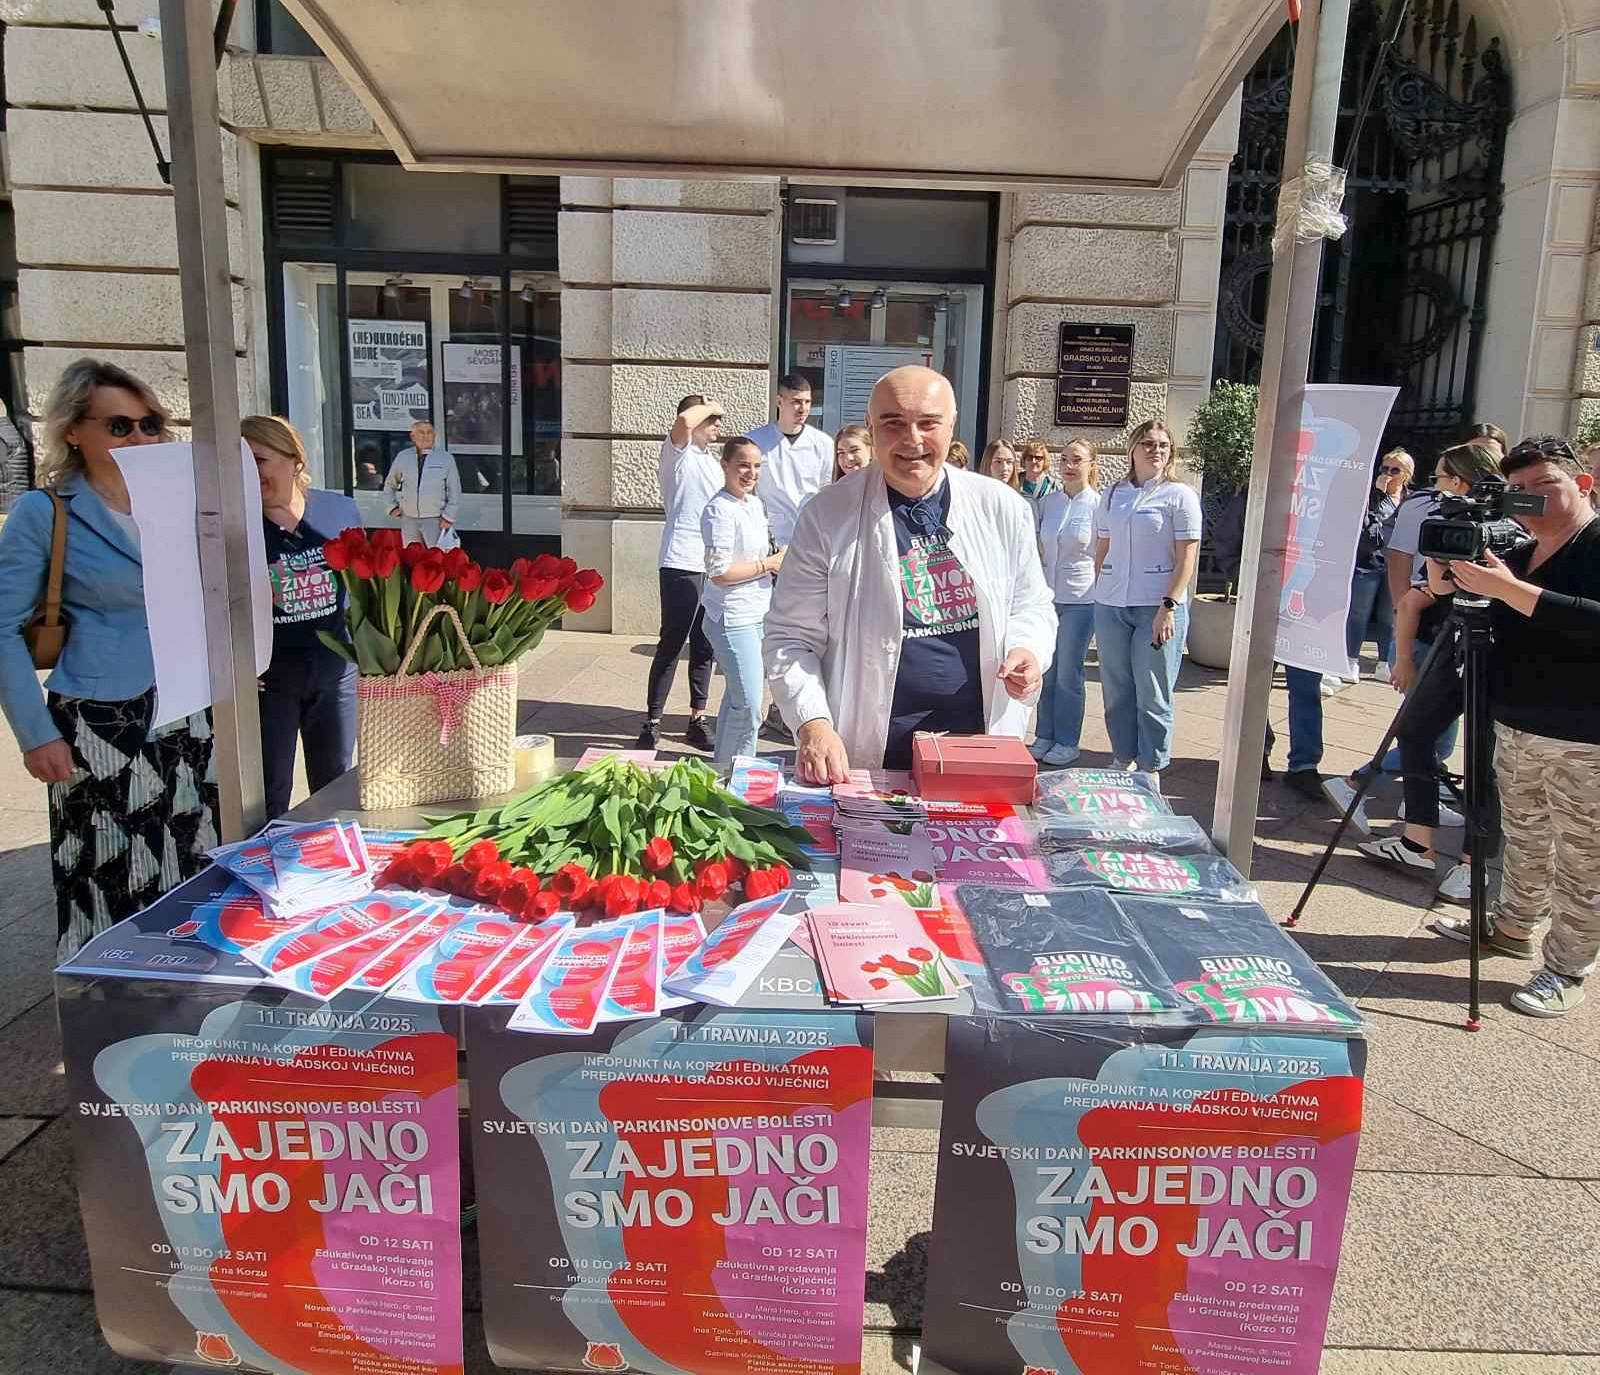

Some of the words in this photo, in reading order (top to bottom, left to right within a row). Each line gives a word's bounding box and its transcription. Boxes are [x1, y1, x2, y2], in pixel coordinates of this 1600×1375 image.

[352, 346, 379, 360] MORE
[473, 348, 501, 357] MOST
[1063, 354, 1100, 362] GRADSKO
[1102, 354, 1129, 363] VIJEĆE
[382, 391, 427, 407] (UN)TAMED
[1060, 404, 1125, 414] GRADONAČELNIK
[281, 569, 333, 592] ŽIVOT
[282, 588, 311, 601] NIJE
[284, 601, 311, 614] ČAK
[313, 598, 327, 608] NI
[329, 594, 337, 604] S
[273, 605, 337, 624] ARKINSONOM
[1034, 953, 1129, 971] BUDIMO
[1200, 956, 1294, 977] BUDIMO
[1041, 963, 1134, 980] #ZAJEDNO
[1212, 970, 1303, 987] #ZAJEDNO
[759, 977, 812, 993] KBC
[257, 1010, 281, 1024] 11.
[285, 1011, 366, 1030] TRAVNJA
[369, 1016, 417, 1032] 2025.
[670, 1026, 695, 1040] 11.
[701, 1027, 782, 1044] TRAVNJA
[786, 1031, 833, 1046] 2025.
[173, 1038, 249, 1051] INFOPUNKT
[252, 1042, 271, 1053] NA
[273, 1043, 318, 1056] KORZU
[330, 1047, 415, 1062] EDUKATIVNA
[171, 1051, 261, 1066] PREDAVANJA
[263, 1056, 272, 1066] U
[276, 1058, 349, 1071] GRADSKOJ
[351, 1060, 415, 1076] VIJEĆNICI
[583, 1056, 659, 1069] INFOPUNKT
[663, 1060, 682, 1070] NA
[686, 1061, 732, 1072] KORZU
[743, 1063, 829, 1076] EDUKATIVNA
[1159, 1053, 1184, 1067] 11.
[1190, 1054, 1273, 1073] TRAVNJA
[1277, 1059, 1325, 1076] 2025.
[581, 1070, 671, 1084] PREDAVANJA
[674, 1074, 683, 1084] U
[687, 1075, 761, 1087] GRADSKOJ
[765, 1075, 829, 1089] VIJEĆNICI
[1068, 1082, 1146, 1097] INFOPUNKT
[1150, 1087, 1168, 1098] NA
[1173, 1088, 1220, 1101] KORZU
[1231, 1092, 1320, 1106] EDUKATIVNA
[79, 1101, 161, 1117] SVJETSKI
[165, 1102, 201, 1116] DAN
[208, 1101, 344, 1114] PARKINSONOVE
[348, 1101, 422, 1115] BOLESTI
[1063, 1096, 1157, 1112] PREDAVANJA
[1159, 1103, 1168, 1112] U
[1172, 1103, 1248, 1117] GRADSKOJ
[1251, 1106, 1318, 1121] VIJEĆNICI
[482, 1120, 566, 1135] SVJETSKI
[571, 1121, 608, 1134] DAN
[613, 1116, 753, 1133] PARKINSONOVE
[757, 1114, 832, 1129] BOLESTI
[160, 1120, 430, 1164] ZAJEDNO
[951, 1142, 1040, 1160] SVJETSKI
[1045, 1147, 1083, 1160] DAN
[1088, 1146, 1232, 1160] PARKINSONOVE
[1237, 1146, 1317, 1160] BOLESTI
[565, 1134, 839, 1180] ZAJEDNO
[159, 1172, 291, 1216] SMO
[308, 1163, 434, 1216] JAČI
[1034, 1165, 1318, 1208] ZAJEDNO
[564, 1188, 694, 1228] SMO
[711, 1176, 840, 1227] JAČI
[359, 1235, 380, 1247] OD
[384, 1237, 399, 1248] 12
[402, 1239, 433, 1251] SATI
[1024, 1215, 1159, 1257] SMO
[1176, 1209, 1313, 1261] JAČI
[151, 1243, 172, 1254] OD
[193, 1247, 214, 1258] DO
[217, 1249, 232, 1260] 12
[235, 1250, 267, 1262] SATI
[315, 1248, 373, 1260] Edukativna
[376, 1254, 433, 1267] predavanja
[762, 1246, 782, 1257] OD
[787, 1248, 801, 1258] 12
[806, 1248, 837, 1259] SATI
[170, 1261, 219, 1273] Infopunkt
[221, 1267, 234, 1275] na
[236, 1267, 268, 1278] Korzu
[331, 1262, 338, 1270] u
[341, 1262, 388, 1275] Gradskoj
[549, 1257, 570, 1268] OD
[575, 1259, 588, 1268] 10
[592, 1260, 613, 1270] DO
[617, 1261, 632, 1271] 12
[635, 1262, 667, 1272] SATI
[716, 1260, 775, 1272] Edukativna
[777, 1265, 837, 1276] predavanja
[381, 1276, 416, 1288] (Korzo
[419, 1280, 434, 1291] 16)
[567, 1274, 617, 1285] Infopunkt
[620, 1277, 633, 1285] na
[636, 1277, 667, 1287] Korzu
[741, 1272, 790, 1284] Gradskoj
[782, 1286, 816, 1295] (Korzo
[1000, 1281, 1022, 1293] OD
[1026, 1285, 1041, 1295] 10
[1045, 1287, 1066, 1298] DO
[1071, 1290, 1086, 1300] 12
[1090, 1291, 1123, 1304] SATI
[1224, 1281, 1246, 1292] OD
[1251, 1283, 1267, 1295] 12
[1270, 1285, 1304, 1297] SATI
[1016, 1299, 1069, 1312] Infopunkt
[1071, 1306, 1084, 1314] na
[1087, 1307, 1120, 1318] Korzu
[1174, 1292, 1236, 1307] Edukativna
[1239, 1301, 1300, 1313] predavanja
[1199, 1306, 1250, 1321] Gradskoj
[1253, 1313, 1298, 1324] vijećnici
[1240, 1322, 1277, 1333] (Korzo
[1280, 1326, 1296, 1336] 16)
